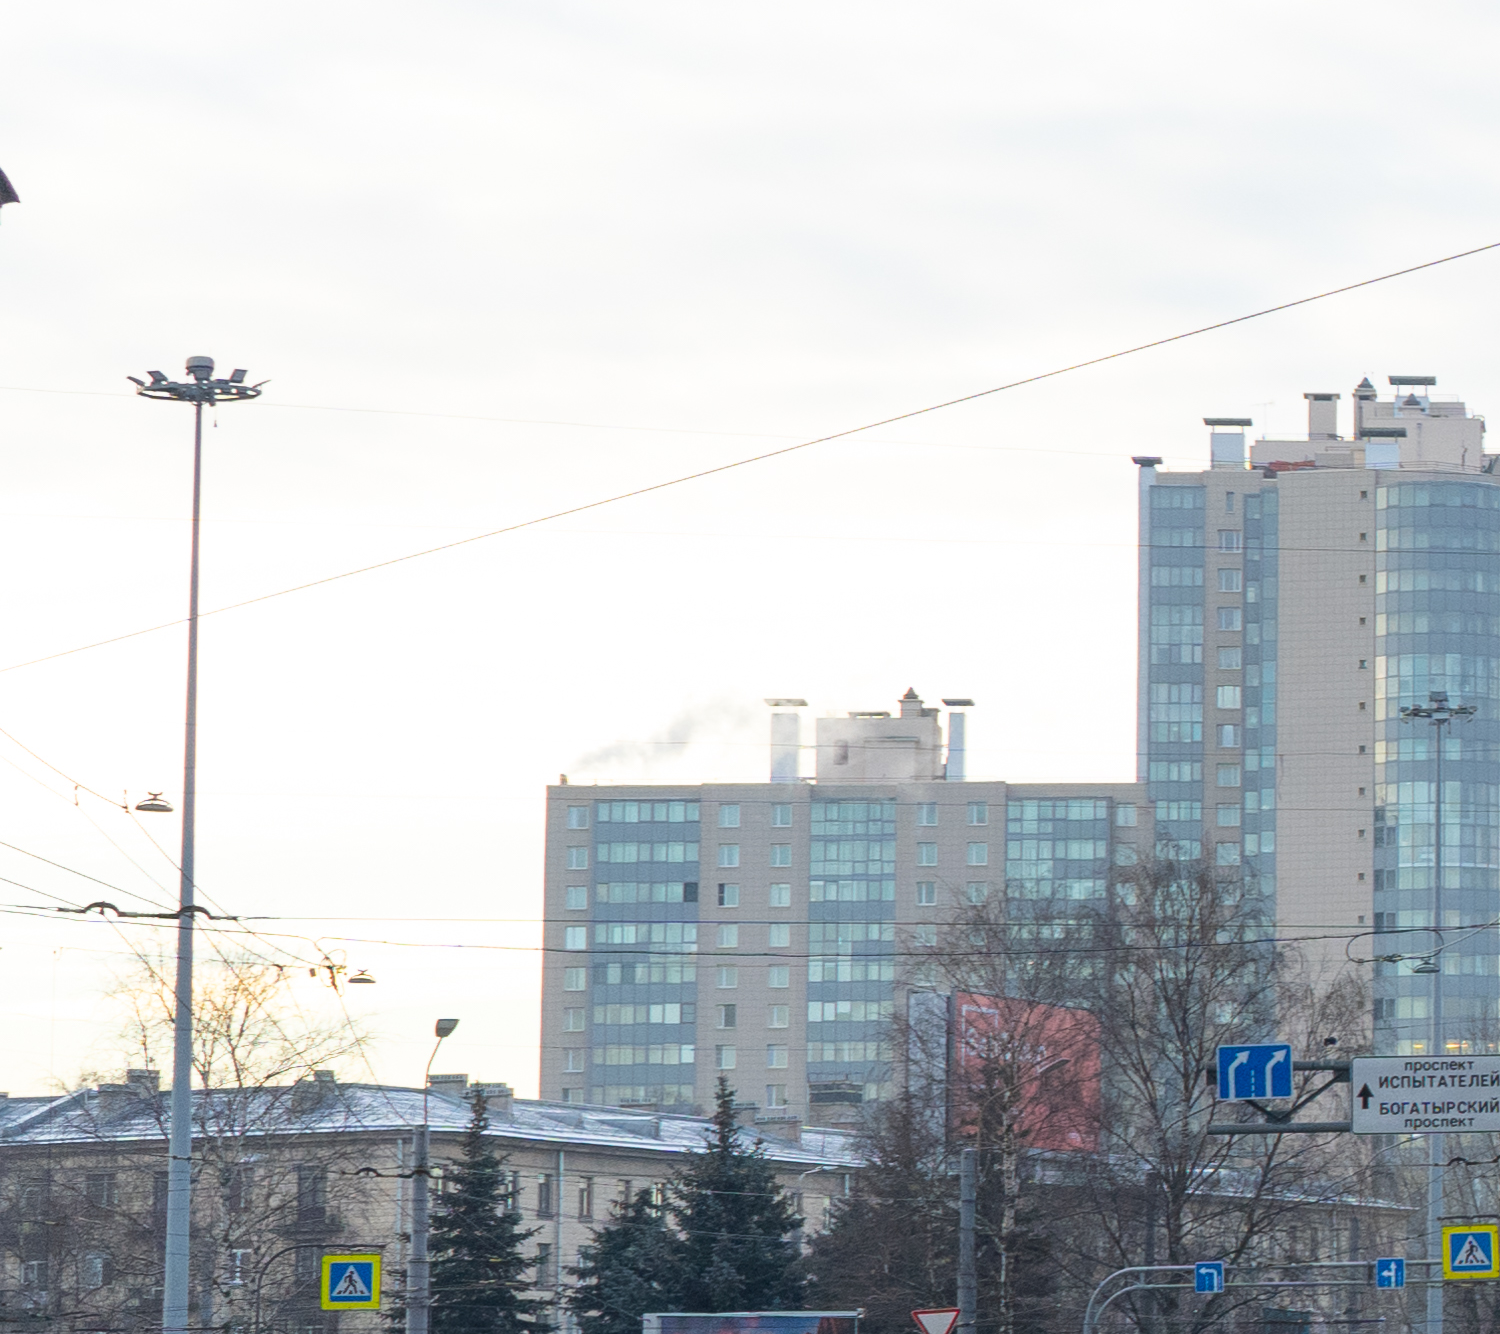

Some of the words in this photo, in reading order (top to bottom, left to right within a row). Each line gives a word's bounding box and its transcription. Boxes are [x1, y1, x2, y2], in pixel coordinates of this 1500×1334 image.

[1404, 1061, 1475, 1074] проспект
[1378, 1070, 1500, 1088] ИСПЫТАТЕЛЕЙ
[1379, 1097, 1500, 1115] БОГАТЫРСКИЙ
[1404, 1117, 1475, 1130] проспект
